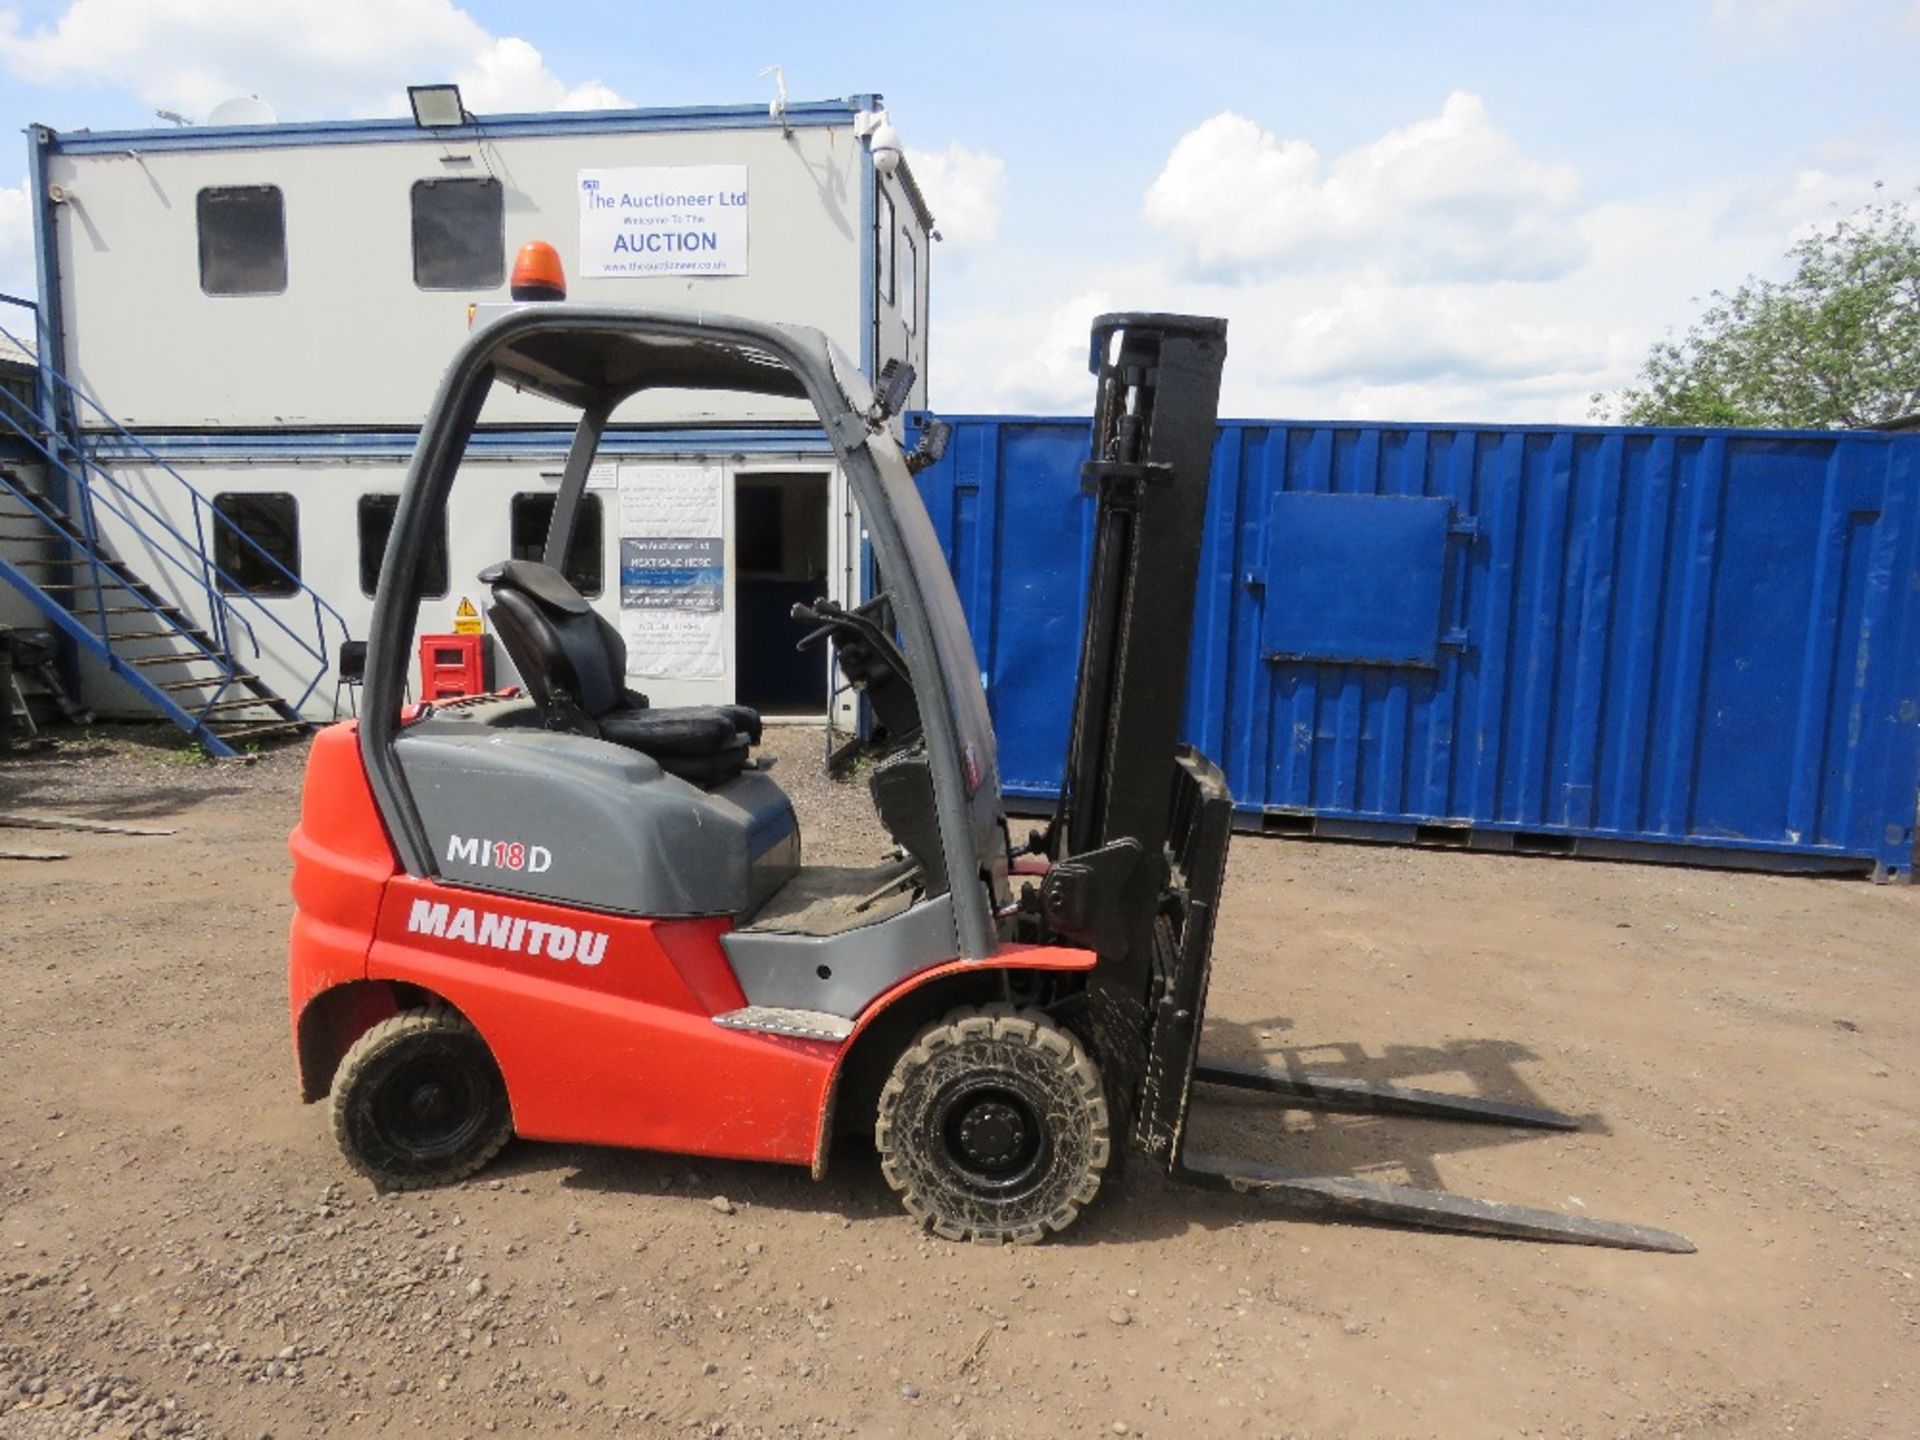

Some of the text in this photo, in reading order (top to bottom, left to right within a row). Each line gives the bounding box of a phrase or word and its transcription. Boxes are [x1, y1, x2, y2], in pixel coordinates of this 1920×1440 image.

[586, 187, 747, 209] The Auctioneer Ltd
[613, 232, 718, 252] AUCTION
[447, 835, 552, 873] MI18D
[408, 898, 609, 965] MANITOU
